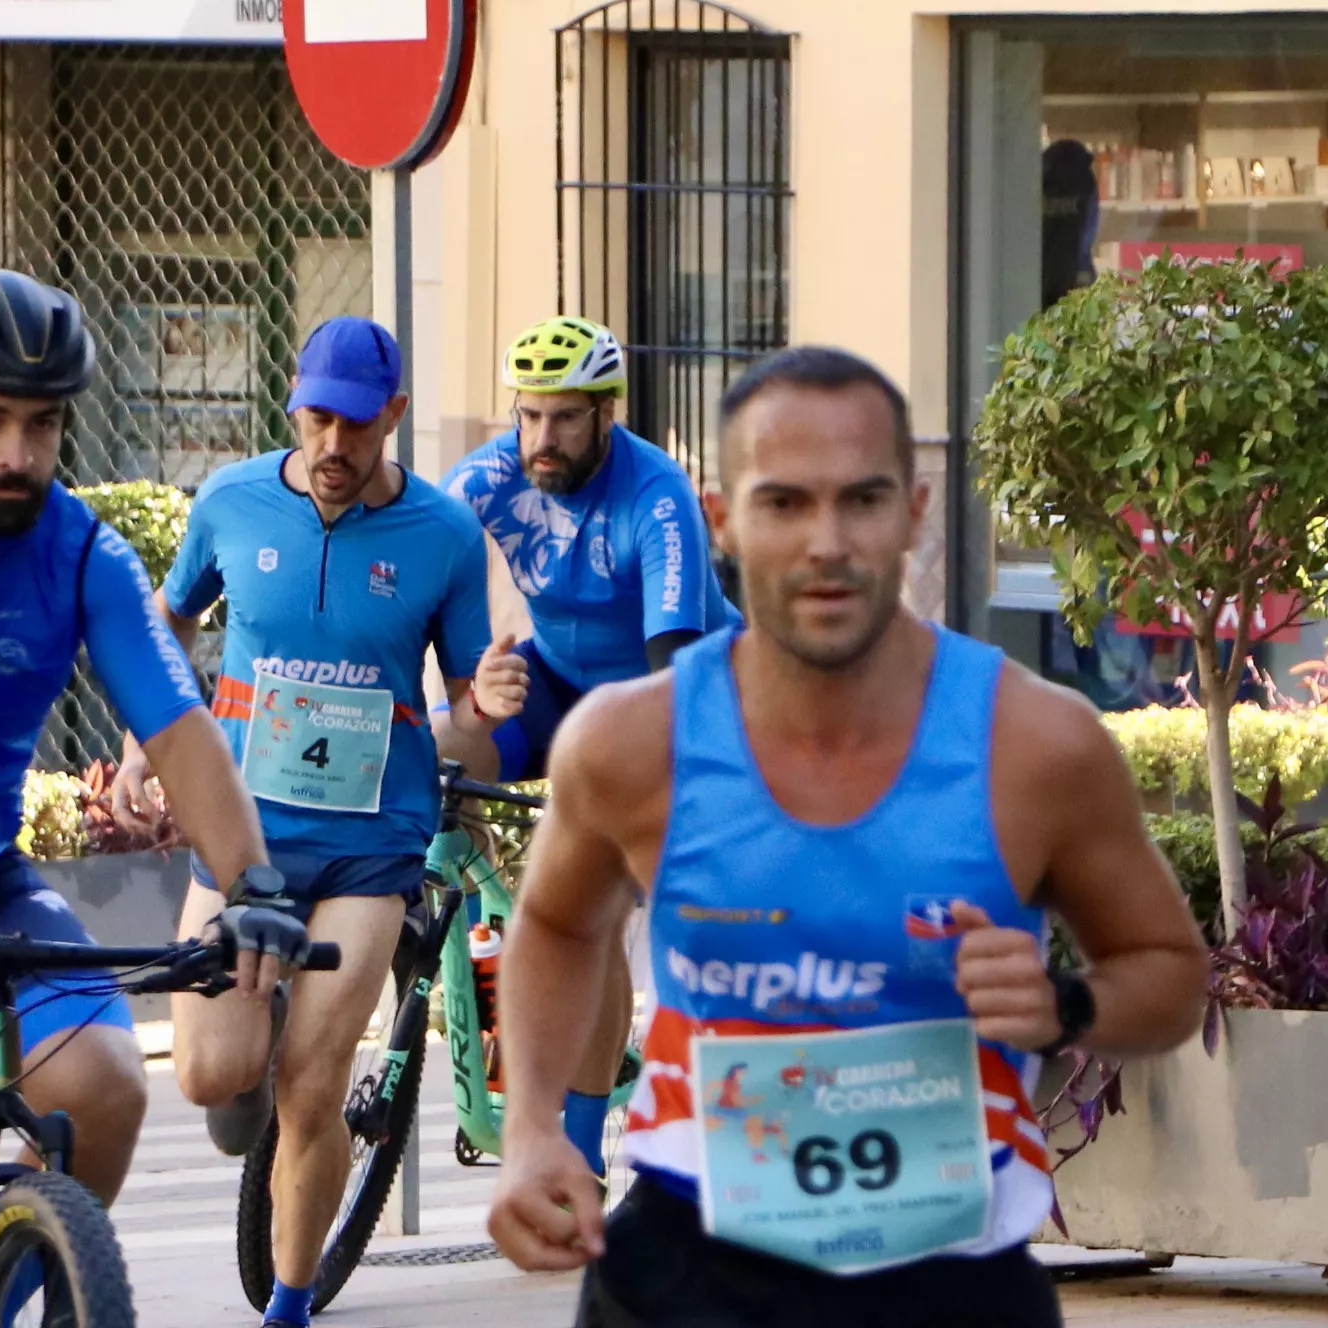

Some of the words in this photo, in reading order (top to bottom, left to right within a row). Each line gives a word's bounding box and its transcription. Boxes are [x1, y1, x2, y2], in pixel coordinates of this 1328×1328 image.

[661, 520, 682, 616] HARMAN
[252, 657, 381, 684] enerplus
[301, 737, 329, 769] 4
[381, 1061, 404, 1101] FOX
[793, 1128, 902, 1196] 69
